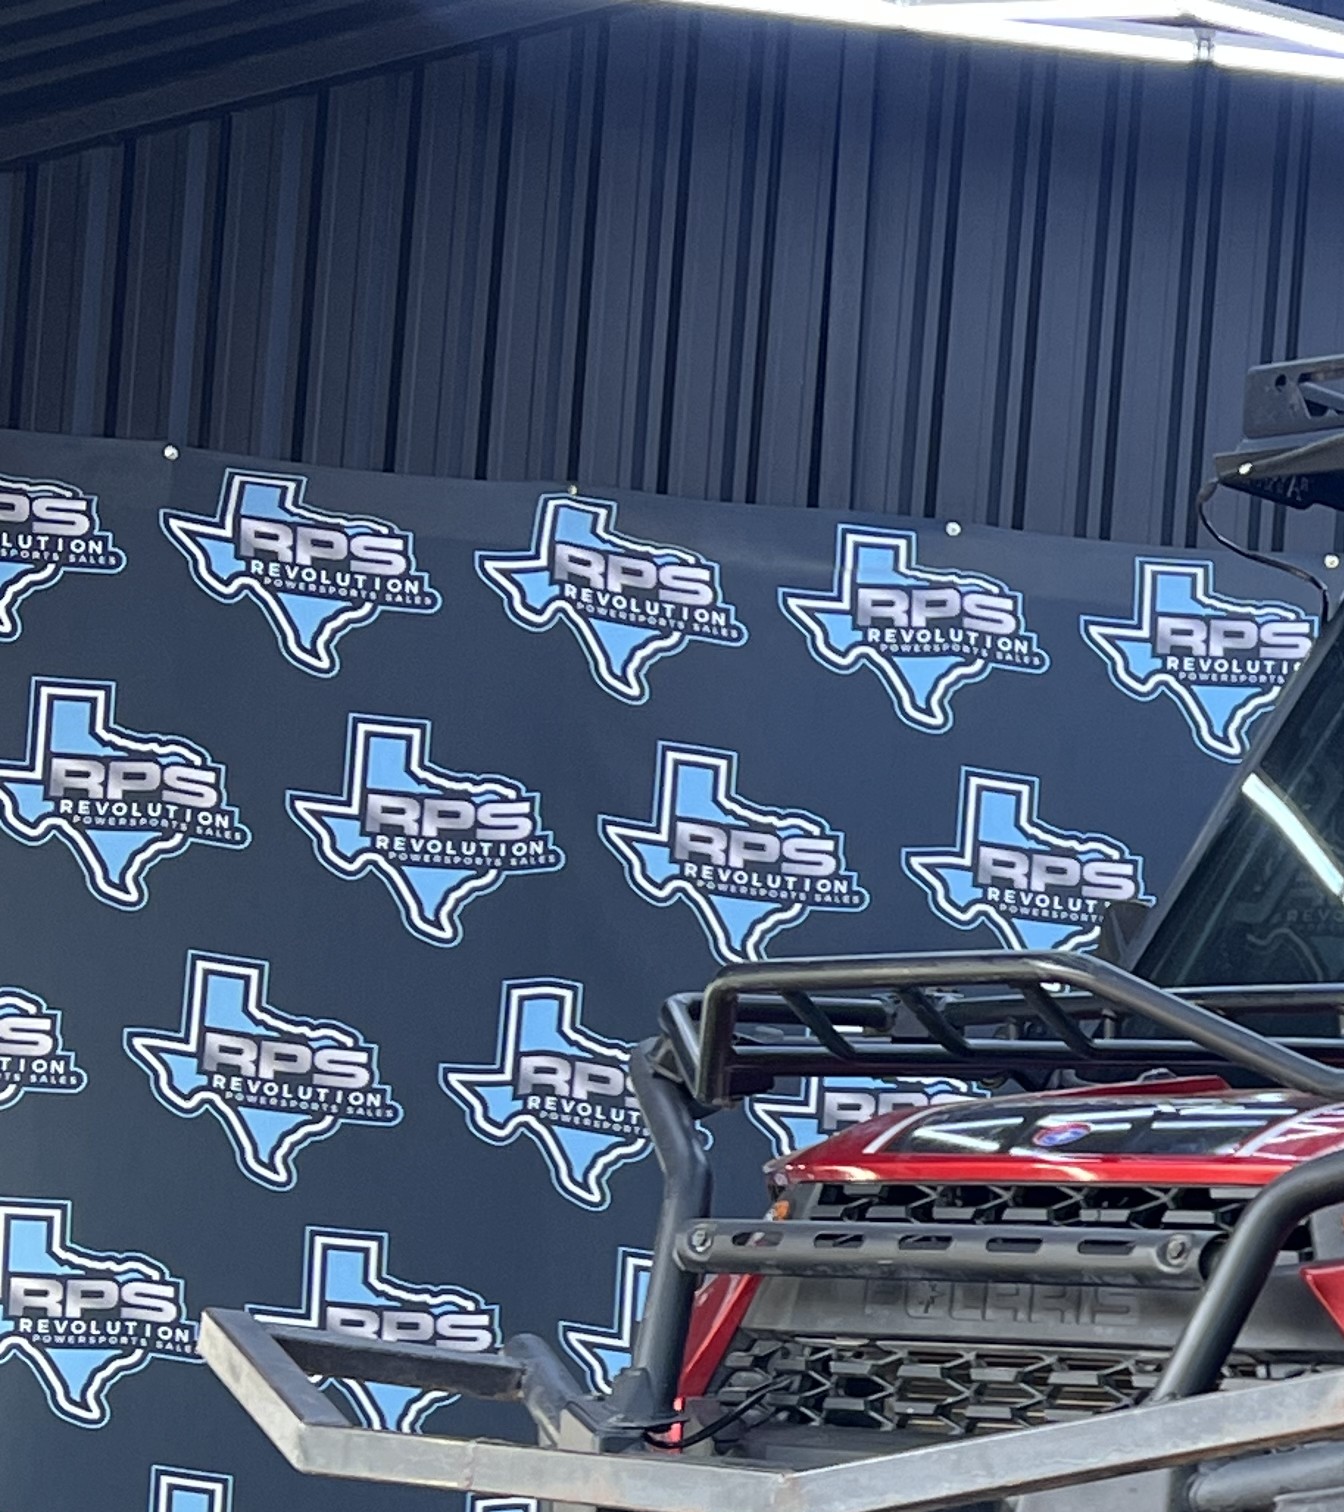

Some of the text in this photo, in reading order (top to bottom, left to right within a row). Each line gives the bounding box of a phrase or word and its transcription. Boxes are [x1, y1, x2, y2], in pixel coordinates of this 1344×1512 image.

[0, 494, 90, 537] PS
[2, 532, 103, 554] LUTION
[240, 517, 406, 577] RPS
[69, 555, 117, 566] SALES
[554, 542, 713, 608] RPS
[250, 560, 419, 594] REVOLUTION
[263, 577, 432, 606] POWERSPORTS SALES
[564, 584, 725, 625] REVOLUTION
[857, 588, 1016, 636] RPS
[576, 602, 738, 638] POWERSPORTS SALES
[867, 628, 1027, 653] REVOLUTION
[1157, 616, 1312, 660] RPS
[880, 643, 1040, 666] POWERSPORTS SALES
[1166, 656, 1301, 672] REVOLUTI
[48, 758, 217, 810] RPS
[59, 799, 229, 828] REVOLUTION
[72, 815, 241, 841] POWERSPORTS SALES
[365, 794, 532, 838] RPS
[376, 835, 544, 854] REVOLUTION
[388, 851, 556, 866] POWERSPORTS SALES
[674, 822, 836, 876] RPS
[684, 863, 848, 893] REVOLUTION
[979, 846, 1136, 901] RPS
[696, 879, 860, 904] POWERSPORTS SALES
[988, 886, 1110, 913] REVOLUT
[202, 1032, 369, 1089] RPS
[30, 1073, 77, 1085] SALES
[212, 1074, 381, 1106] REVOLUTION
[225, 1091, 393, 1118] POWERSPORTS SALES
[526, 1096, 642, 1122] REVOLUT
[8, 1278, 178, 1322] RPS
[20, 1320, 188, 1343] REVOLUTION
[325, 1306, 493, 1352] RPS
[33, 1334, 197, 1354] POWERSPORTS SALE
